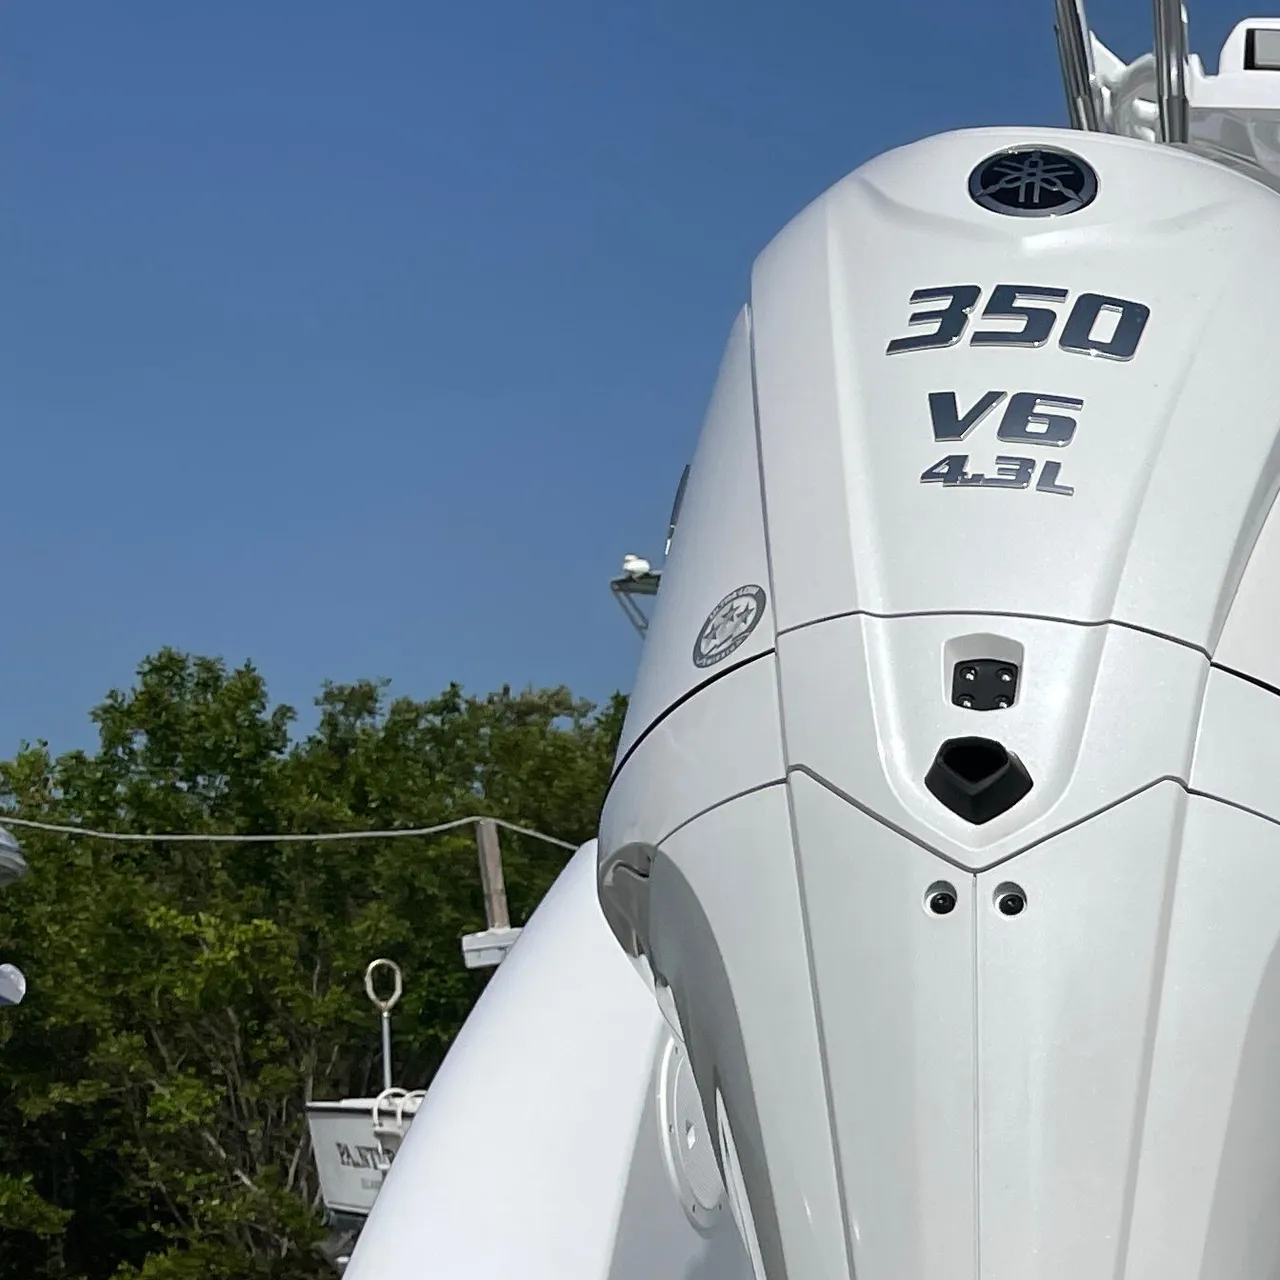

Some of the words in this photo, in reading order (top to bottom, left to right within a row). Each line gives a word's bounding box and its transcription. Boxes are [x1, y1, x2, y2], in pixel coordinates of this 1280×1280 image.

[886, 284, 1150, 362] 350
[928, 391, 1084, 447] V6
[919, 455, 1075, 496] 4.3L
